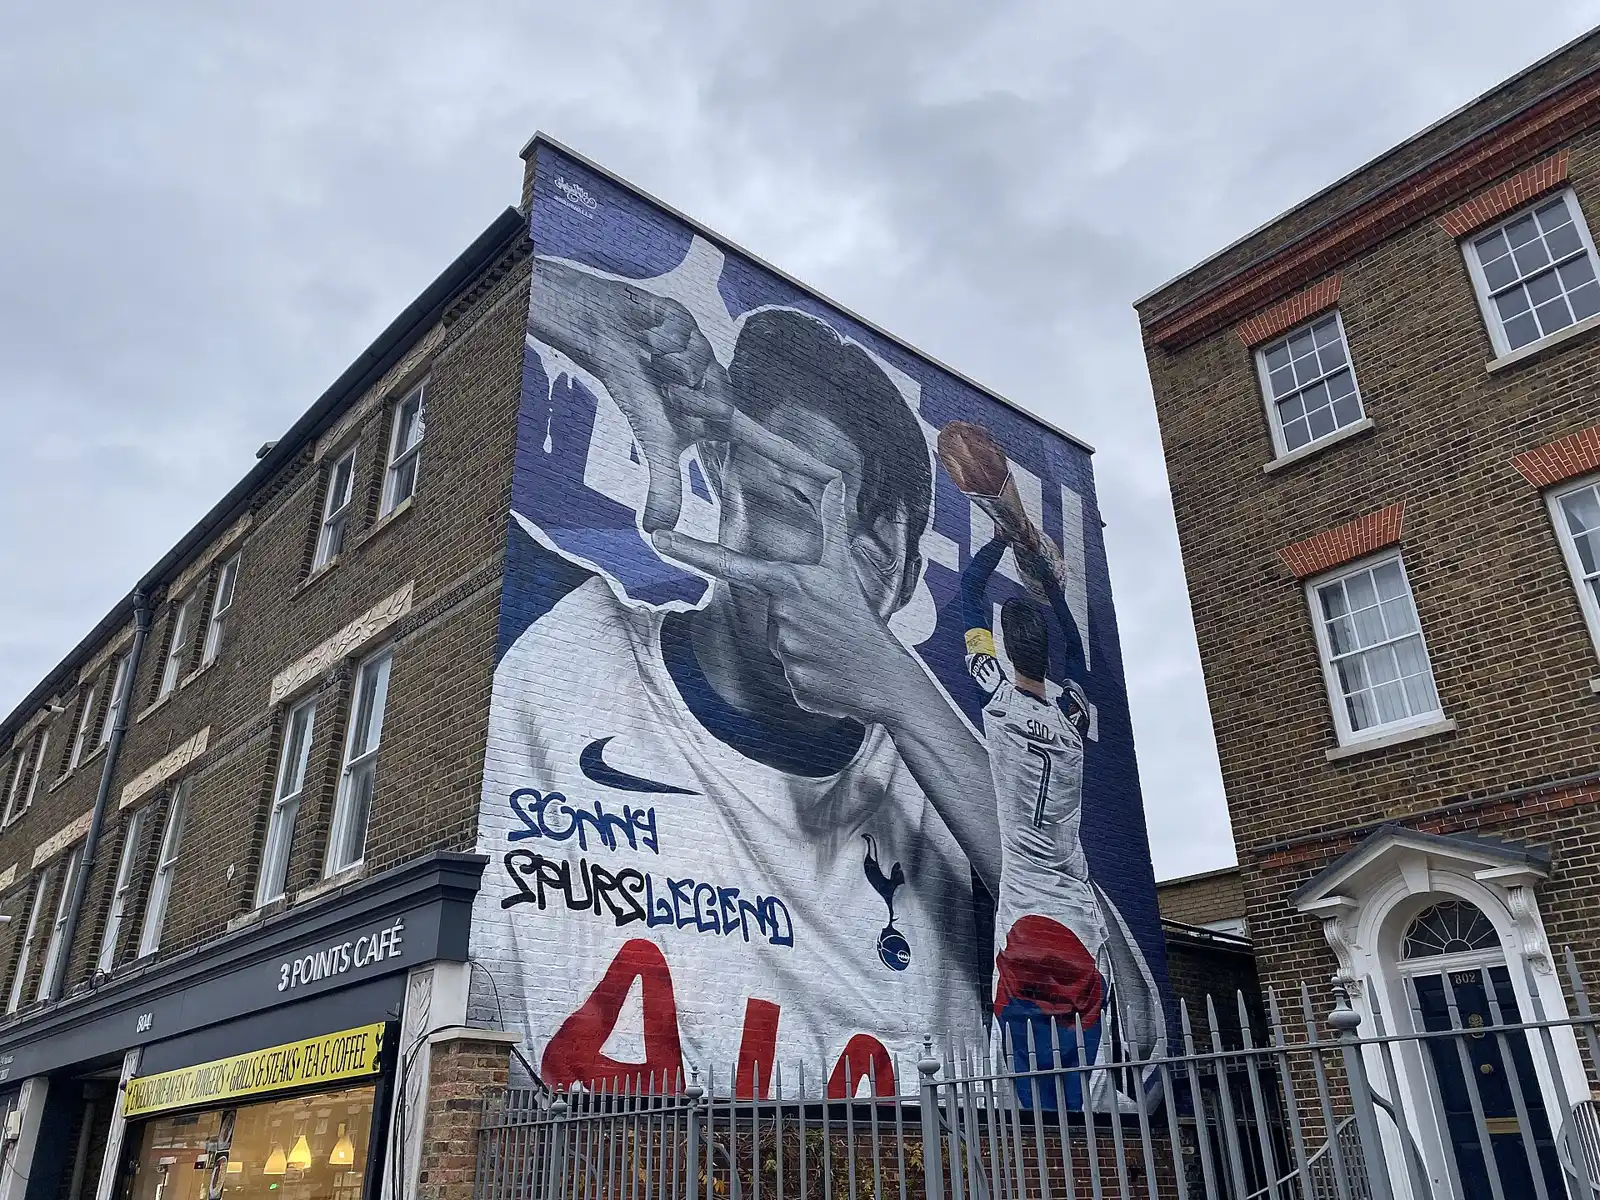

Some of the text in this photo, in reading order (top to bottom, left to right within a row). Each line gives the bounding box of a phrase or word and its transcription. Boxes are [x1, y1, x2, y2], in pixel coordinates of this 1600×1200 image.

[1026, 718, 1049, 741] SON
[1027, 741, 1052, 829] 7
[506, 787, 659, 855] SONNY
[500, 848, 795, 948] SPURS LEGEND
[278, 917, 404, 992] 3 POINTS CAFÉ
[1455, 972, 1476, 985] 802
[190, 1063, 228, 1098] BURGERS
[229, 1056, 259, 1093] GRILLS
[263, 1047, 298, 1086] STEAKS
[301, 1042, 322, 1079] TEA
[321, 1039, 331, 1076] &
[330, 1032, 368, 1074] COFFEE
